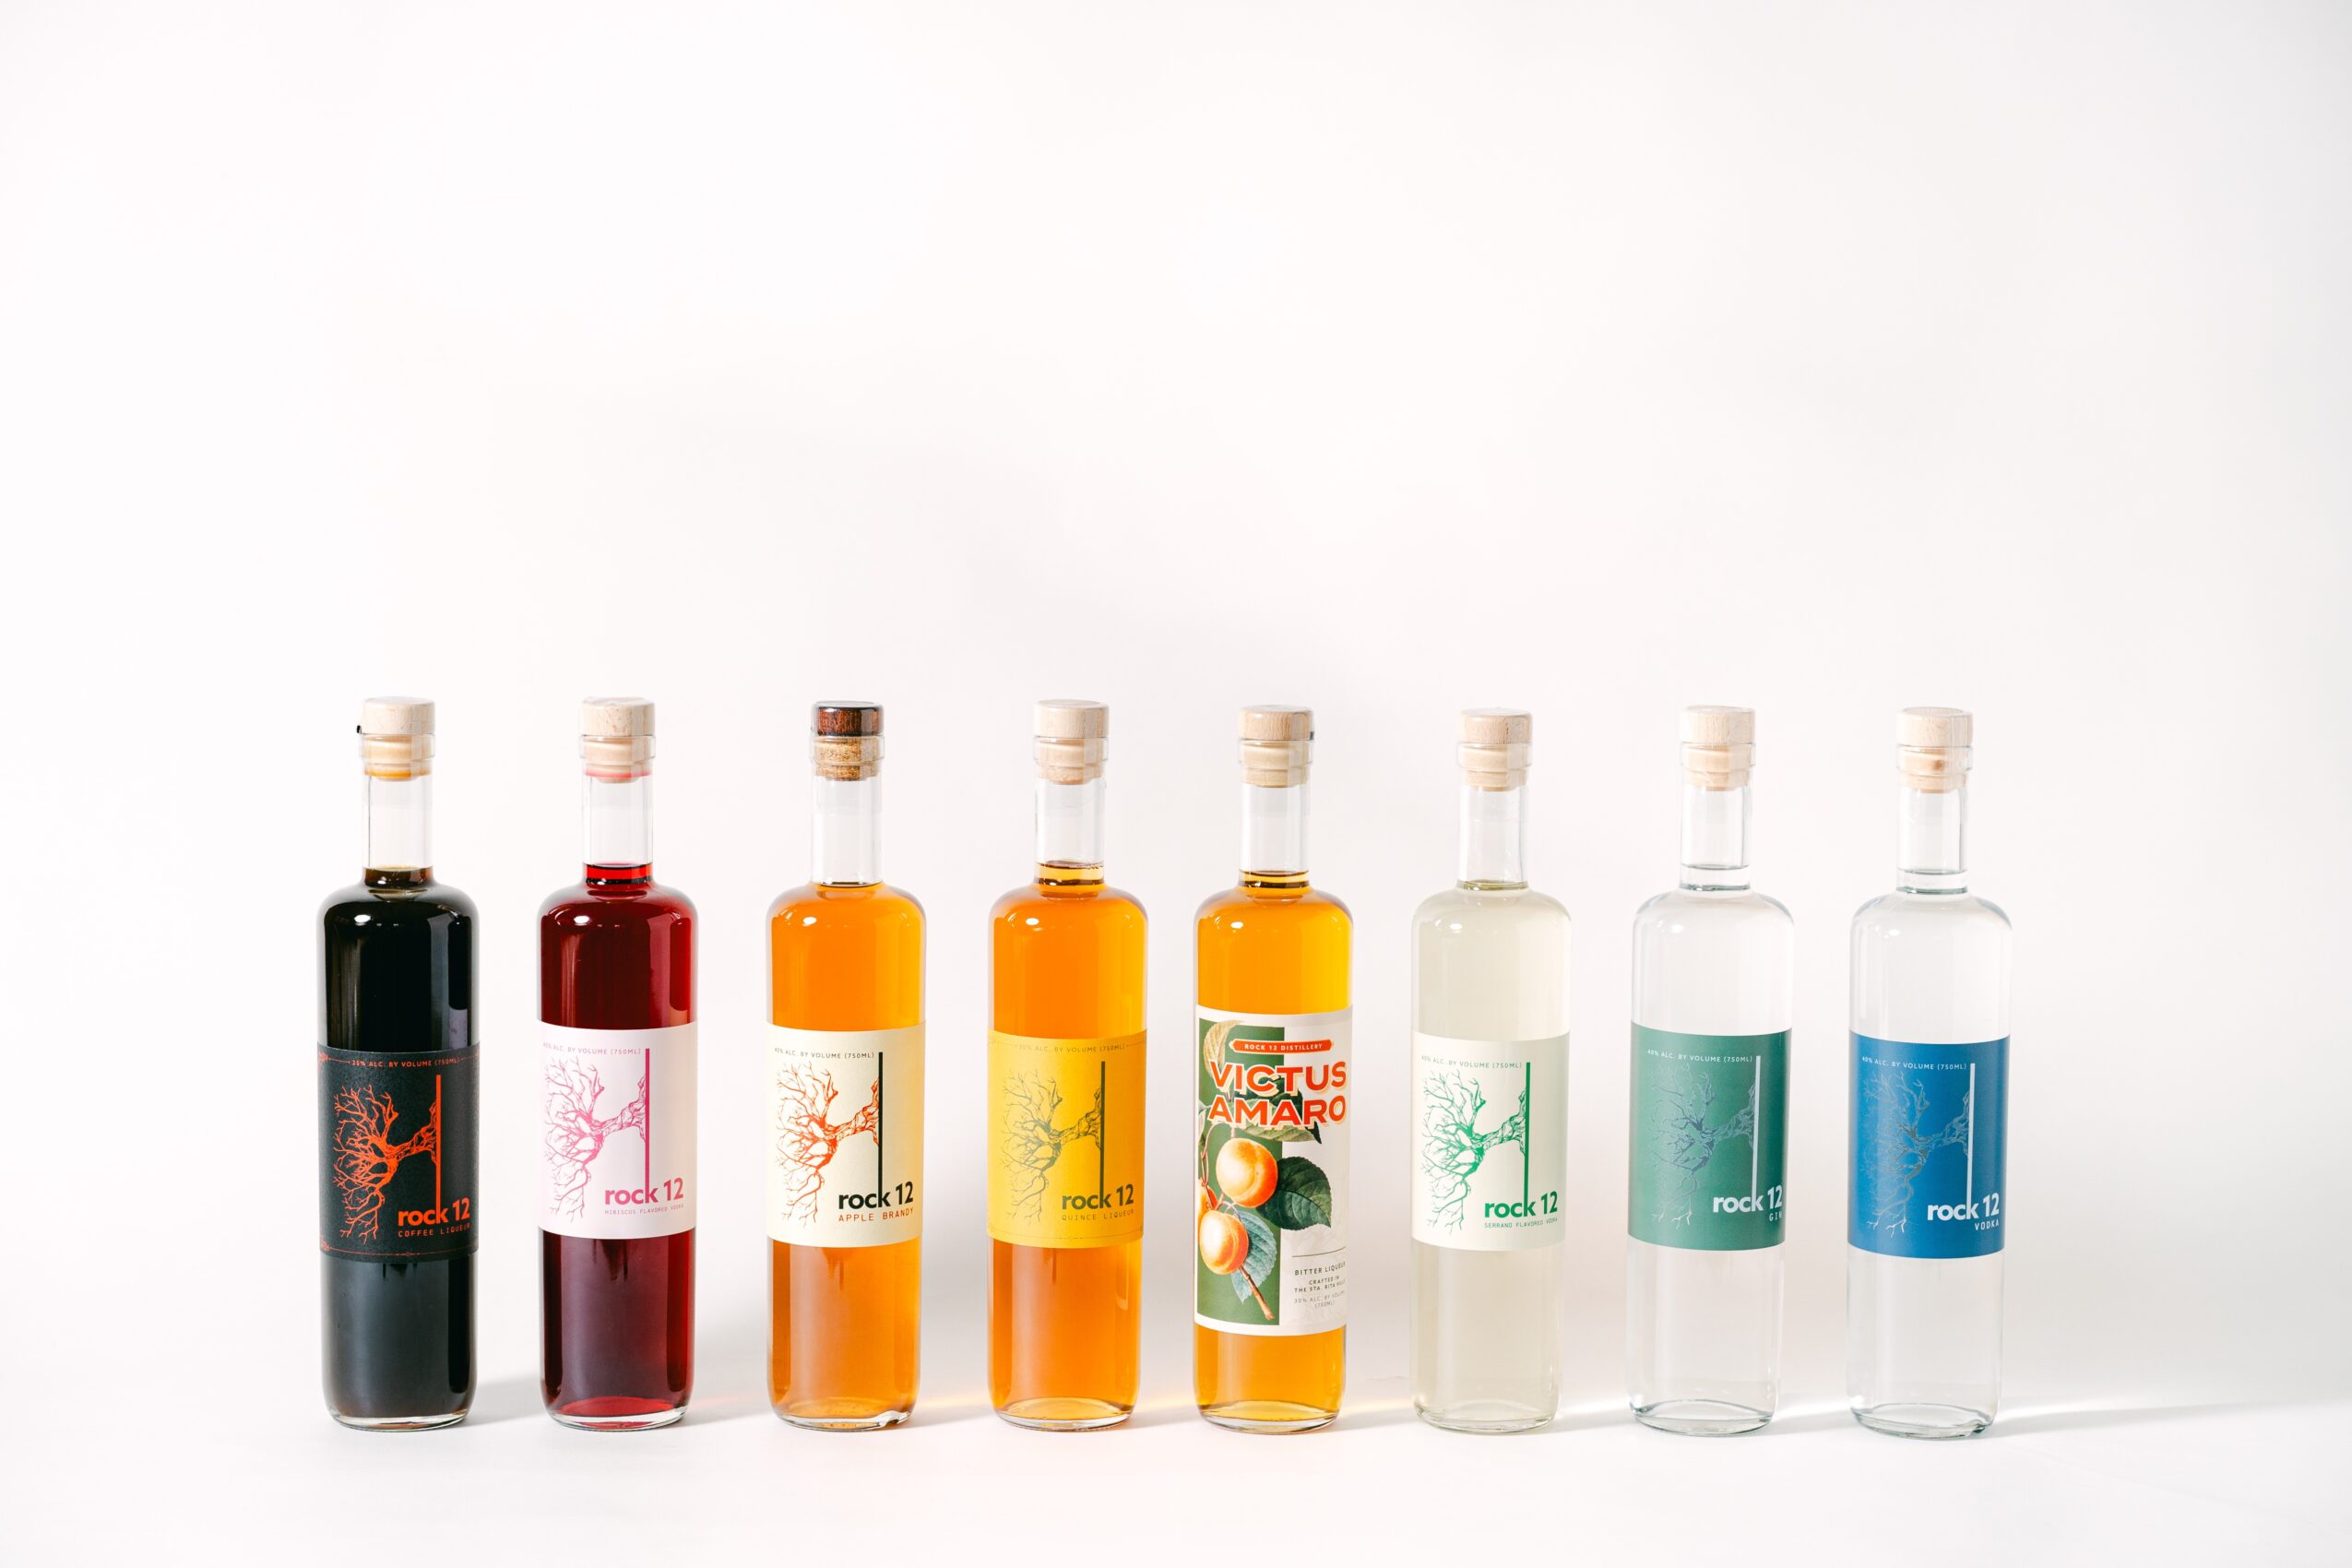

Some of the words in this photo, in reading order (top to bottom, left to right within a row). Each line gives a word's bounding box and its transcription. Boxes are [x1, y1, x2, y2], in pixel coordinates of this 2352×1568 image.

[1660, 1051, 1675, 1059] ALC.
[1209, 1061, 1348, 1095] VICTUS
[1207, 1095, 1347, 1129] AMARO
[605, 1182, 659, 1205] rock
[664, 1177, 684, 1201] 12
[838, 1187, 891, 1210] rock
[895, 1181, 914, 1205] 12
[1062, 1189, 1112, 1210] rock
[1116, 1183, 1134, 1207] 12
[1484, 1196, 1536, 1218] rock
[1541, 1190, 1557, 1214] 12
[1713, 1190, 1764, 1213] rock
[1767, 1185, 1783, 1209] 12
[398, 1203, 449, 1226] rock
[452, 1197, 470, 1221] 12
[838, 1212, 874, 1222] APPLE
[882, 1207, 914, 1220] BRANDY
[1104, 1209, 1134, 1219] LIQUEUR
[1769, 1211, 1782, 1222] GIN
[1927, 1198, 1979, 1221] rock
[1983, 1192, 2000, 1217] 12
[398, 1229, 434, 1238] COFFEE
[1974, 1219, 1999, 1231] VODKA
[1294, 1267, 1323, 1276] BITTER
[1309, 1277, 1334, 1285] CRAFTED
